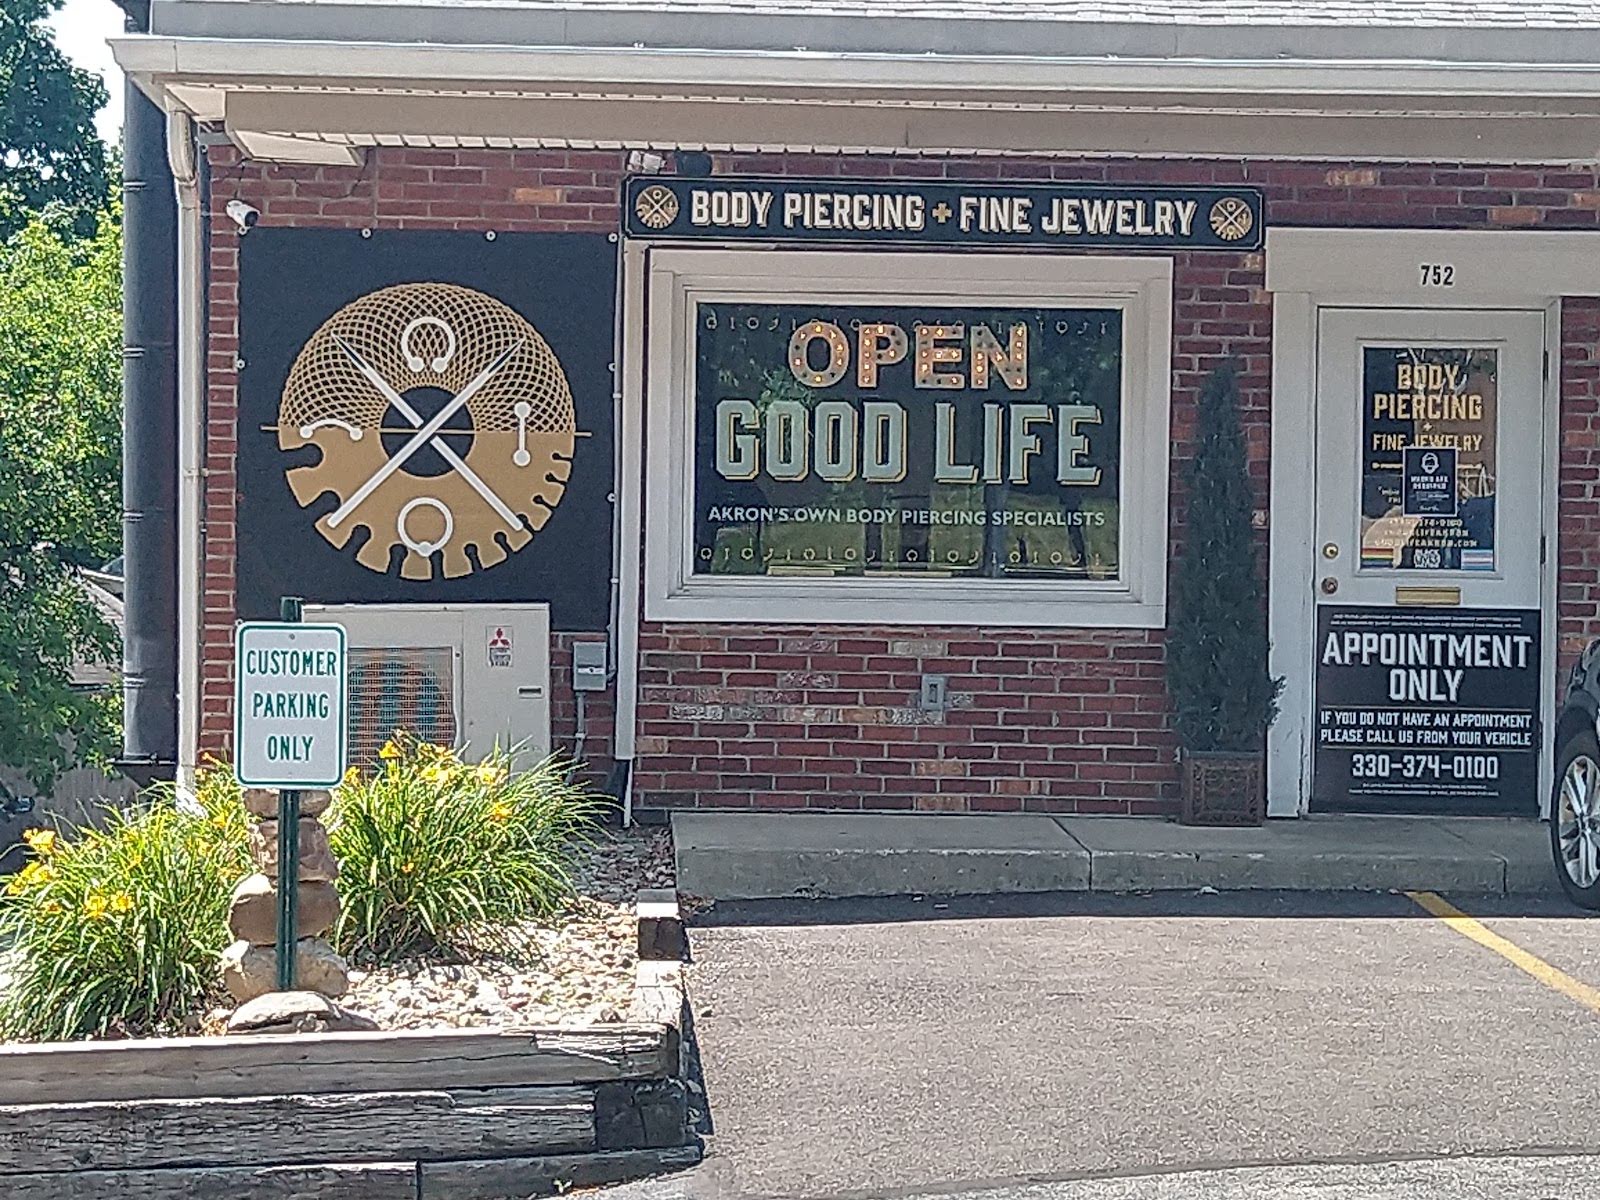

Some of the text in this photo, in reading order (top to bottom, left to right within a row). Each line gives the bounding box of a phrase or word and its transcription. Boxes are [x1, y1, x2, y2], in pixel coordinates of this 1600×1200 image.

[691, 190, 773, 227] BODY
[784, 192, 925, 231] PIERCING
[959, 196, 1033, 233] FINE
[1042, 198, 1198, 237] JEWELRY
[1420, 265, 1453, 286] 752
[788, 321, 1028, 390] OPEN
[1397, 364, 1459, 390] BODY
[1373, 393, 1482, 420] PIERCING
[715, 400, 1102, 486] GOOD LIFE
[1372, 433, 1406, 451] FINE
[708, 506, 1104, 526] AKRON'S OWN BODY PIERCING SPECIALISTS
[1322, 631, 1533, 668] APPOINTMENT
[246, 650, 337, 676] CUSTOMER
[1389, 669, 1464, 702] ONLY
[253, 693, 329, 719] PARKING
[1321, 711, 1532, 728] IF YOU DO NOT HAVE AN APPOINTMENT
[267, 735, 315, 762] ONLY
[1320, 729, 1532, 746] PLEASE CALL US FROM YOUR VEHICLE
[1352, 753, 1499, 779] 330-374-0100
